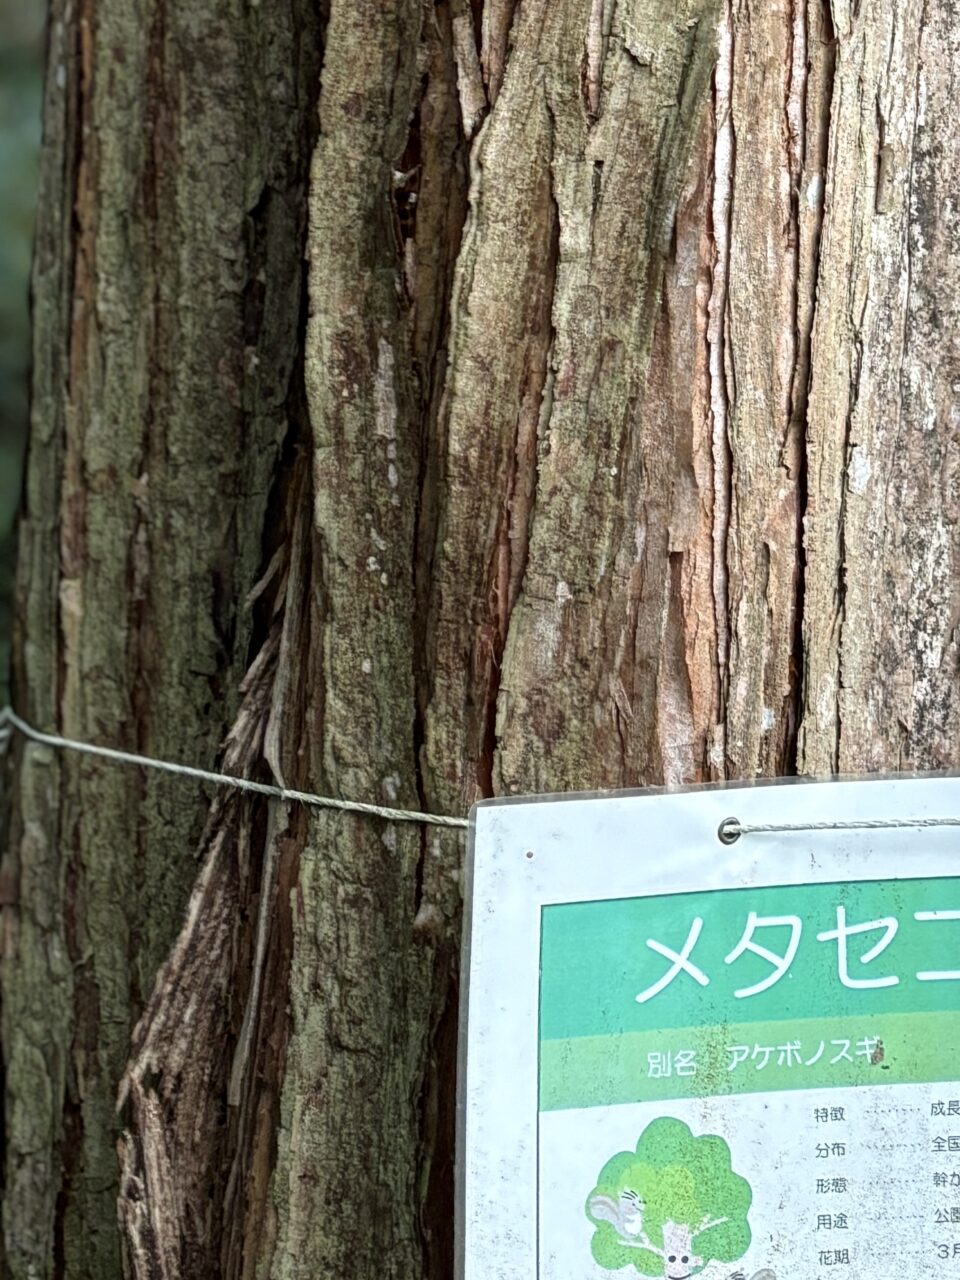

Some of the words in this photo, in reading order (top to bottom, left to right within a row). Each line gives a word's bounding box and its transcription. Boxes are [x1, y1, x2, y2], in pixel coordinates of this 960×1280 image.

[647, 1050, 698, 1078] 別名
[726, 1035, 882, 1070] アケボノスギ
[814, 1141, 847, 1159] 分布
[815, 1176, 848, 1195] 形態
[816, 1212, 849, 1231] 用途
[817, 1248, 850, 1267] 花期
